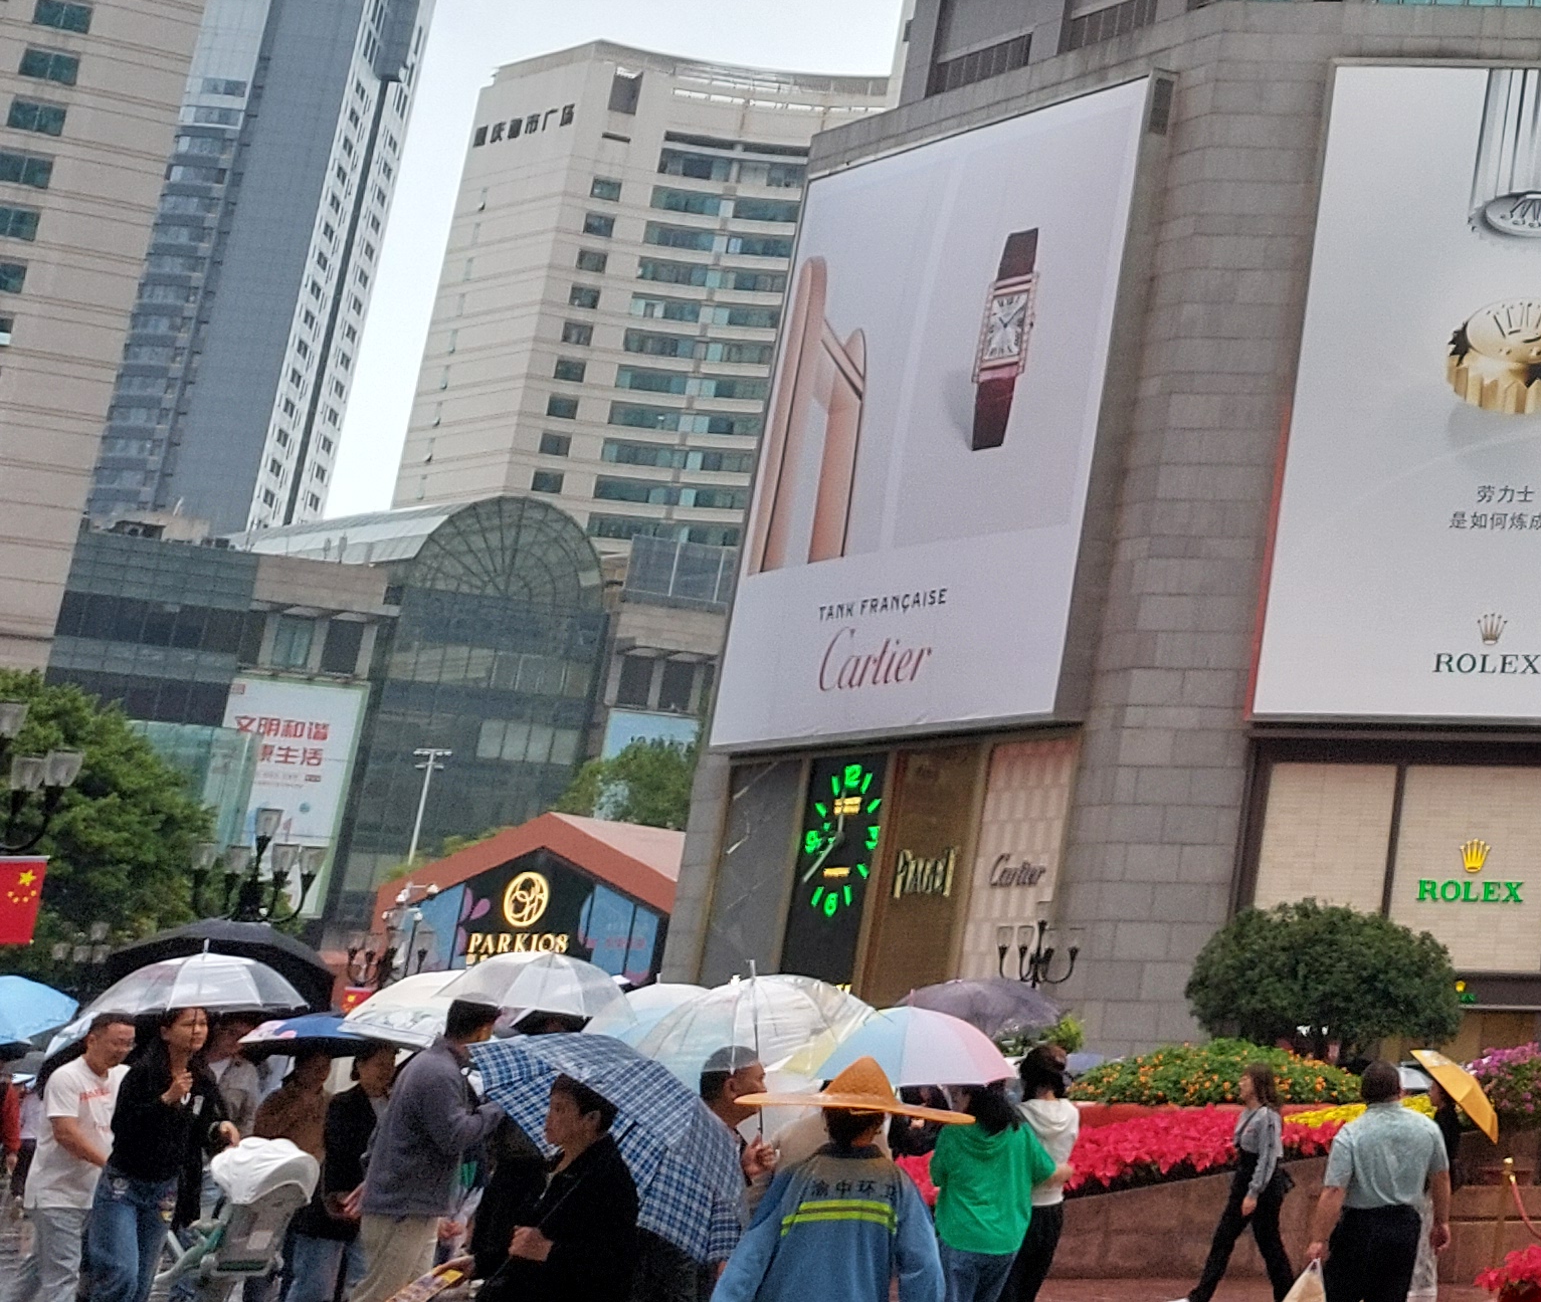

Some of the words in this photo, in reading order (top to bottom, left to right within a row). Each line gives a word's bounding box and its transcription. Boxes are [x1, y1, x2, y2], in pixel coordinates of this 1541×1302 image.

[1477, 485, 1535, 503] 劳力士
[819, 602, 856, 621] TANK
[860, 588, 948, 616] FRANÇAISE
[819, 626, 932, 692] Cartier
[1432, 652, 1541, 675] ROLEX
[234, 715, 330, 741] 文明和谐
[989, 853, 1046, 889] Cartier
[1416, 879, 1524, 904] ROLEX
